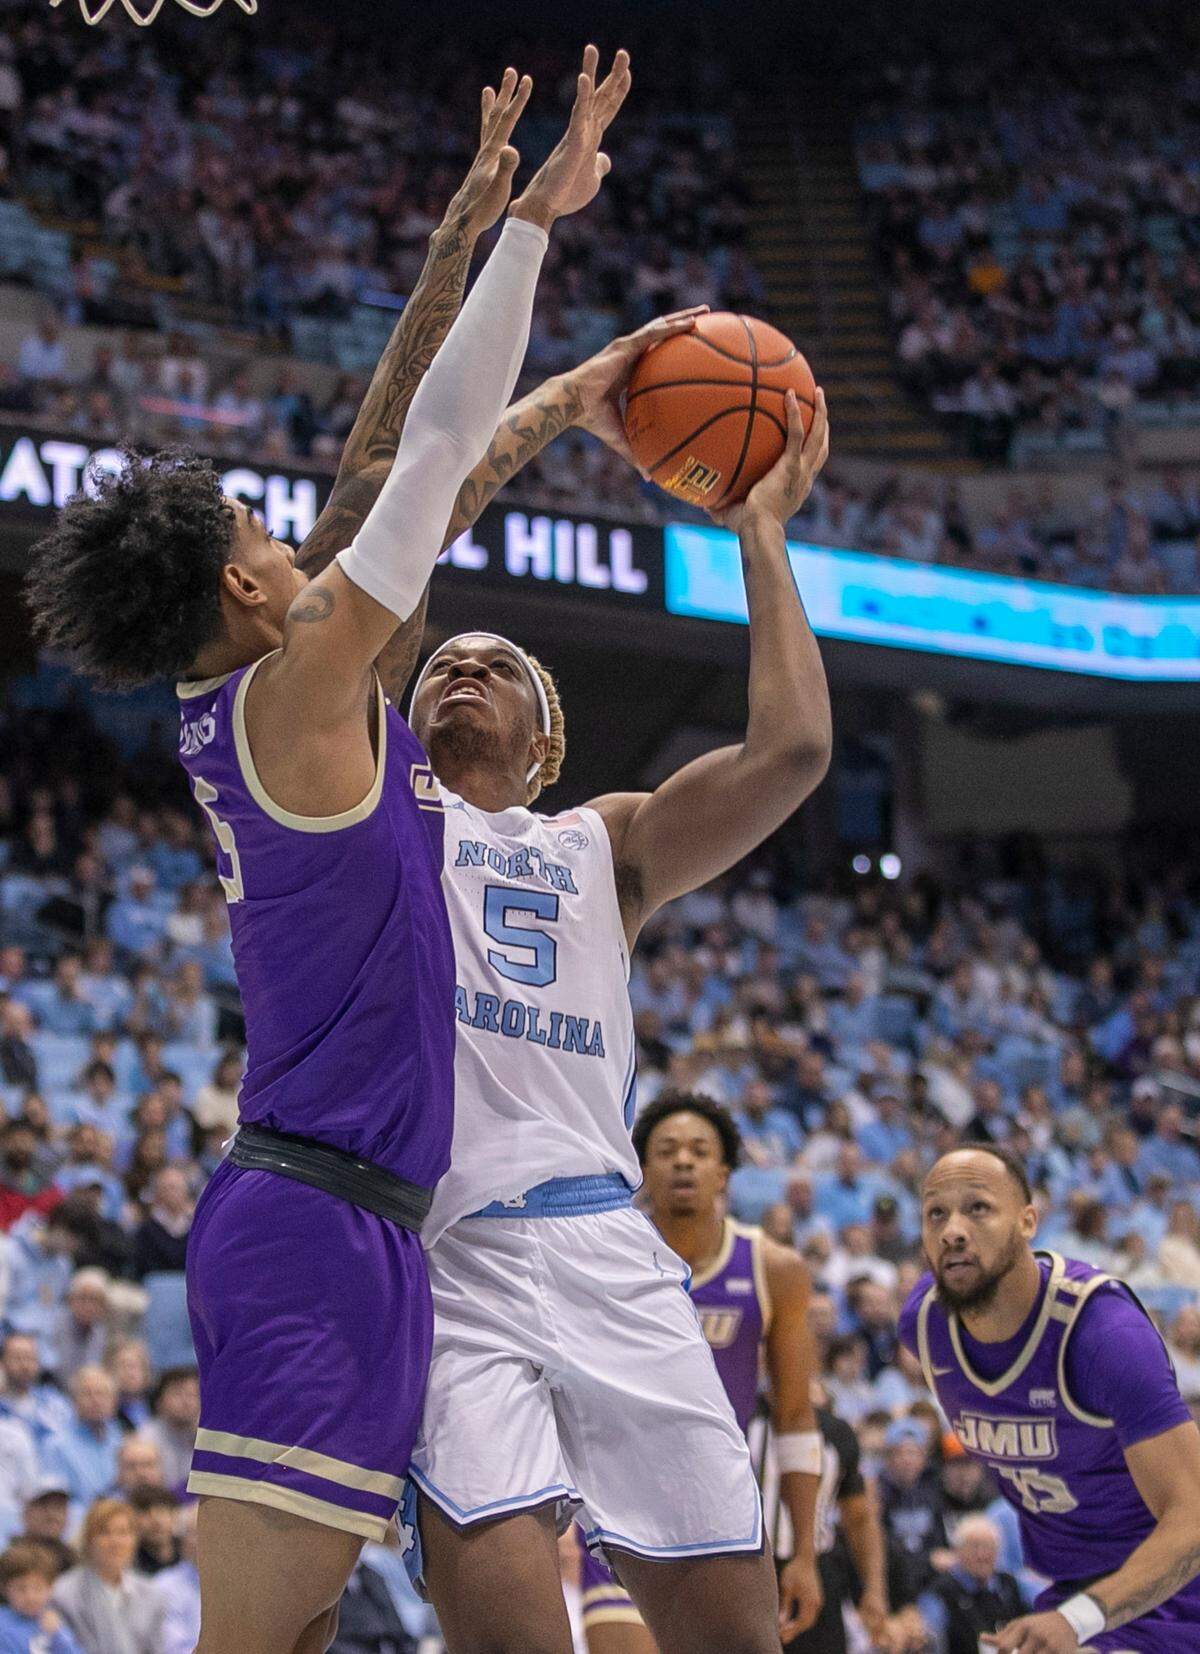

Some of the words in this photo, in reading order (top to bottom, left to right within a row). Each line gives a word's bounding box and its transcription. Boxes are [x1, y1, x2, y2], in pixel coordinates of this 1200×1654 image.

[504, 511, 649, 595] HILL
[455, 839, 579, 895] NORTH
[483, 885, 560, 988] 5
[455, 984, 606, 1058] AROLINA
[956, 1415, 1054, 1458] JMU
